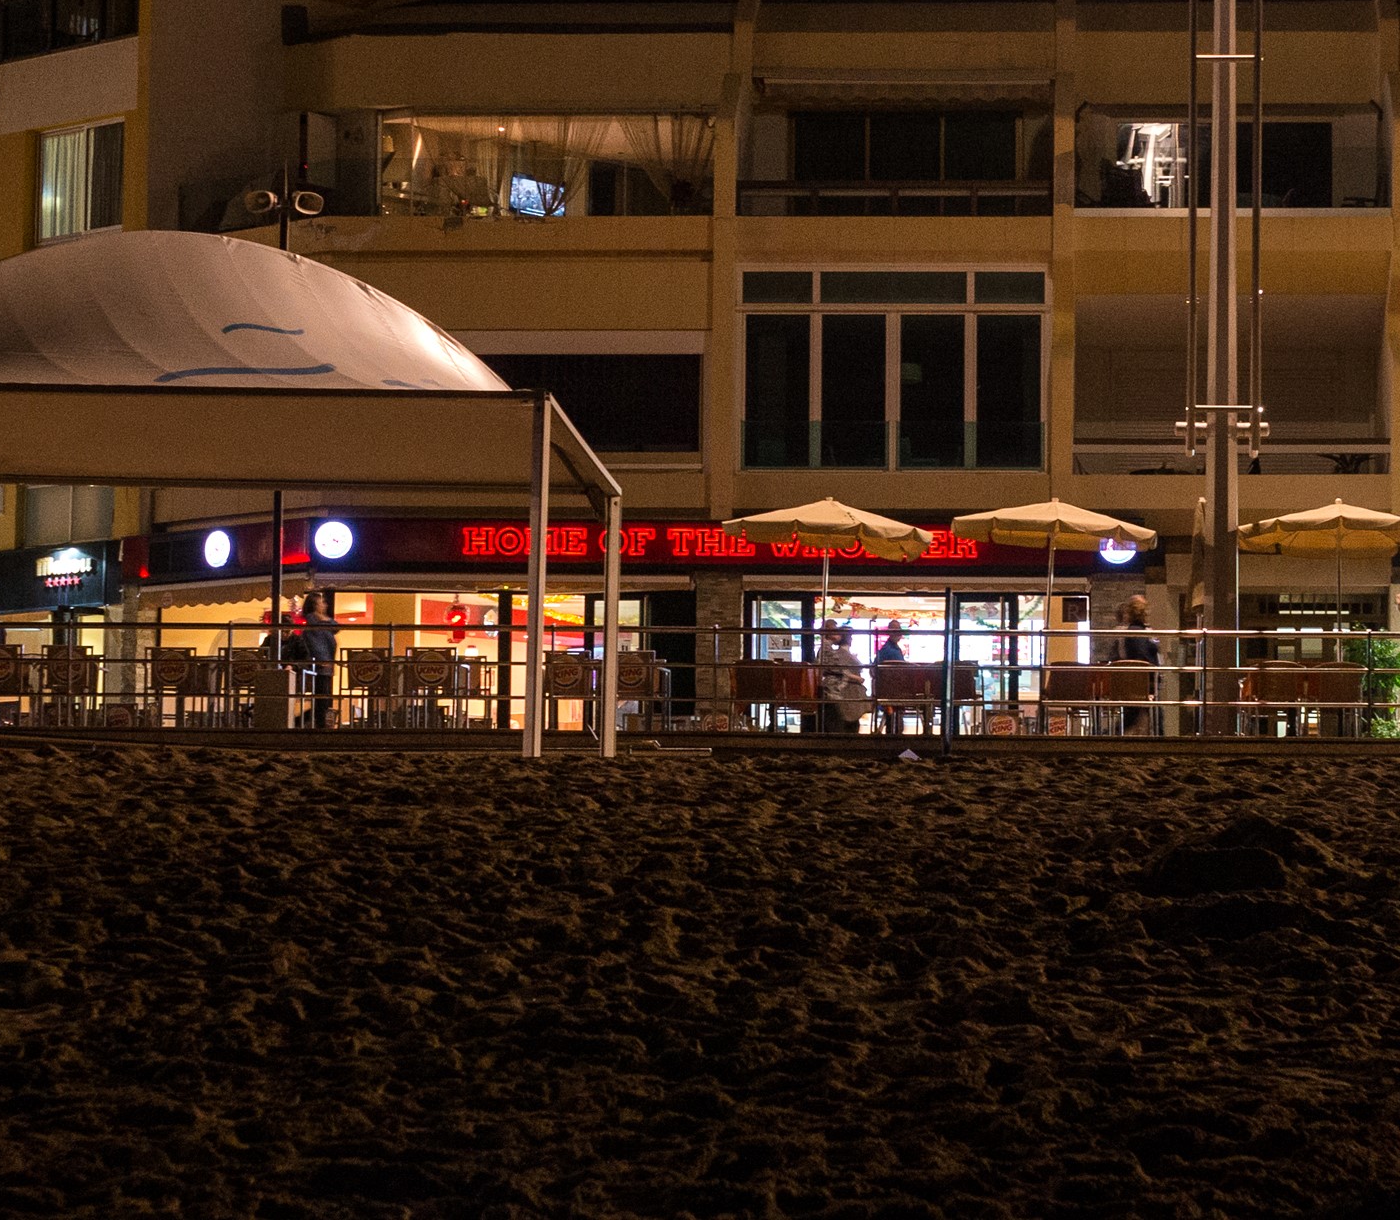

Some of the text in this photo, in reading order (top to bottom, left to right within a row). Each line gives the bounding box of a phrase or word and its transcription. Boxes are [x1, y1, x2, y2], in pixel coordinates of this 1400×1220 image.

[598, 528, 656, 556] OF
[667, 528, 756, 558] THE
[770, 529, 979, 559] WOER
[991, 724, 1013, 733] KING
